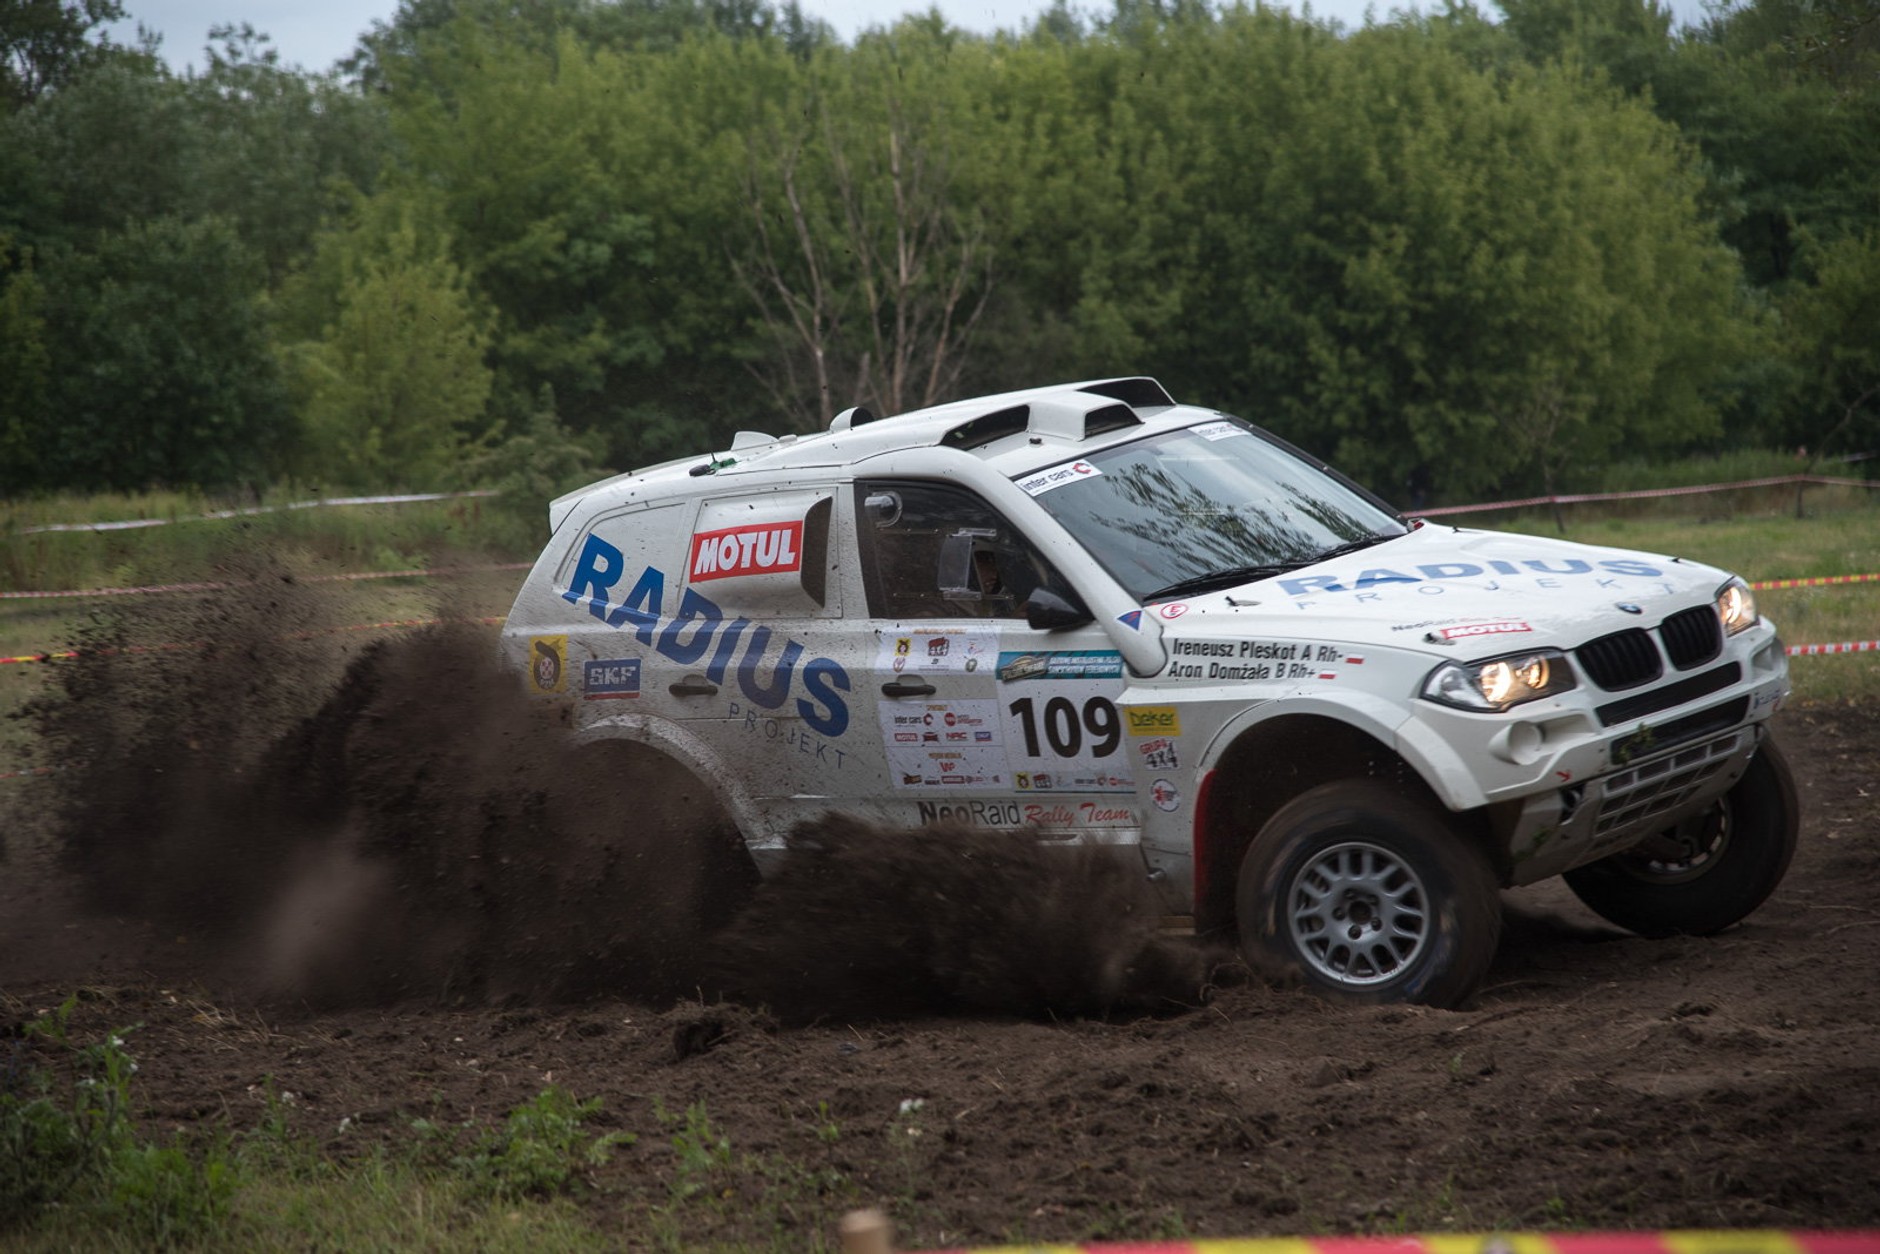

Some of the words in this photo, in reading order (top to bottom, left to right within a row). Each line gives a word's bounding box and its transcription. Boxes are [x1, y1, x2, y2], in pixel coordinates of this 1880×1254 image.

[1020, 475, 1047, 491] inter
[1047, 467, 1074, 483] cars
[693, 528, 797, 576] MOTUL
[1276, 558, 1664, 597] RADIUS
[562, 532, 852, 738] RADIUS
[1447, 622, 1529, 638] MOTUL
[1172, 638, 1234, 658] Ireneusz
[1239, 641, 1299, 661] Pleskot
[1300, 644, 1312, 661] A
[1316, 645, 1344, 663] Rh-
[588, 665, 637, 686] SKF
[1167, 660, 1204, 679] Aron
[1208, 662, 1271, 680] Domżała
[1274, 663, 1286, 679] B
[1287, 664, 1316, 679] Rh+
[1008, 695, 1122, 759] 109
[916, 800, 1021, 826] NeoRaid
[1023, 804, 1075, 828] Rally
[1079, 801, 1131, 823] Team
